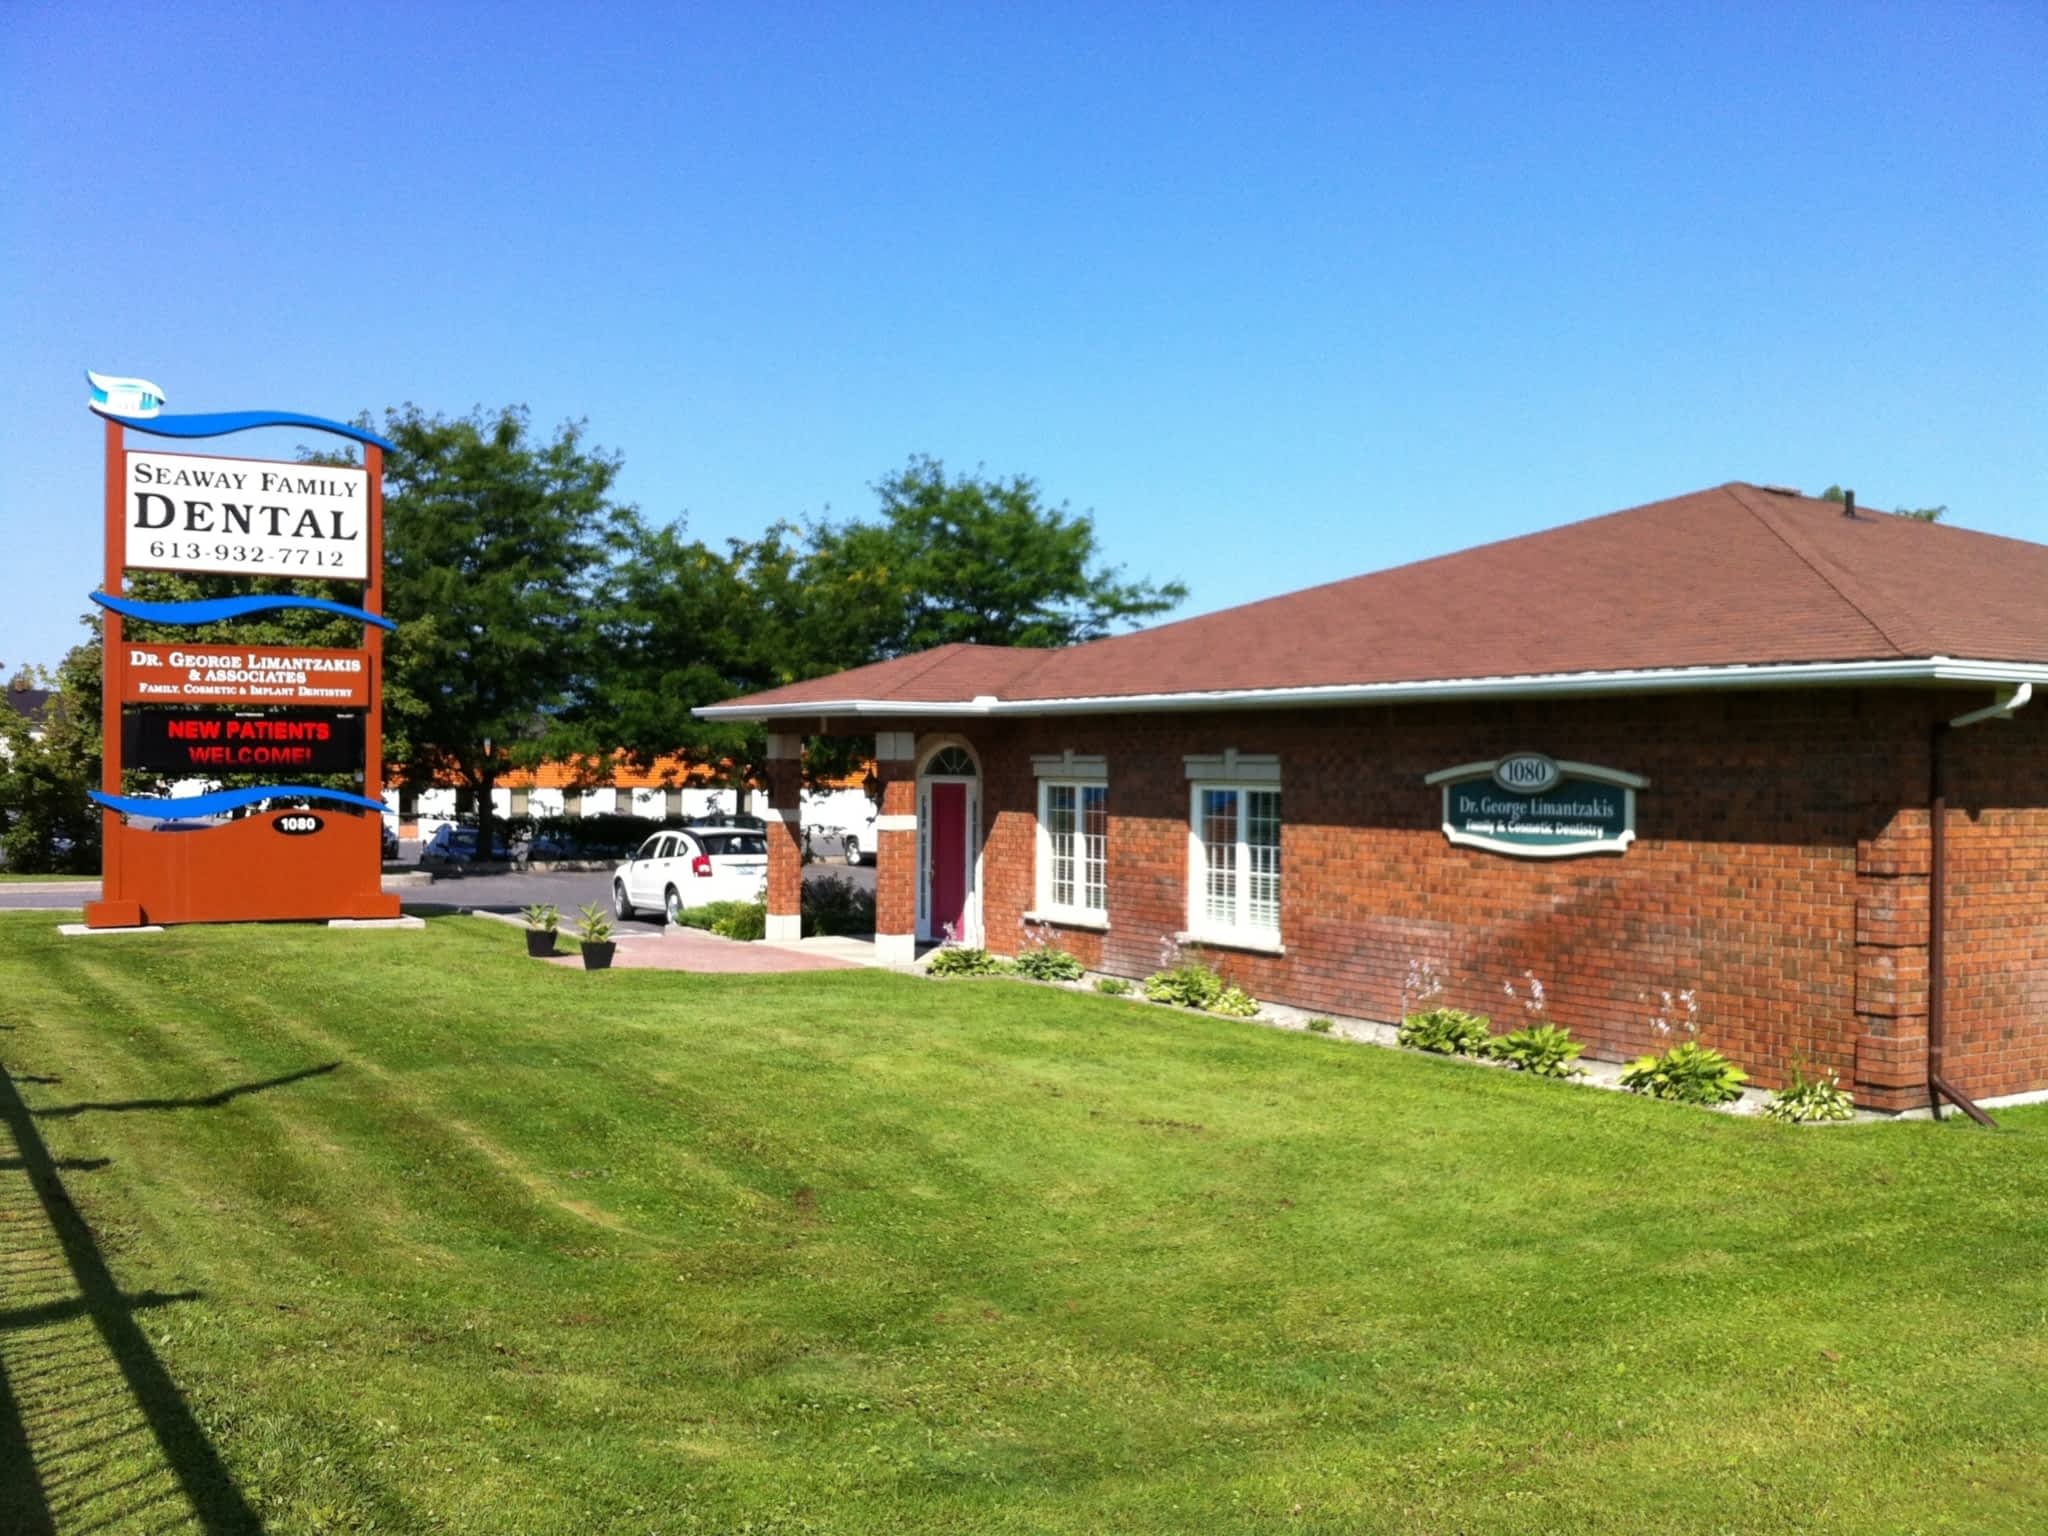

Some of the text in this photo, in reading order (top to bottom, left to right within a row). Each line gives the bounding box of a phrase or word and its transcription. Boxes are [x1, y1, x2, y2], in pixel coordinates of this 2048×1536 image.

[135, 463, 358, 498] SEAWAY FAMILY
[134, 492, 359, 541] DENTAL
[150, 541, 344, 567] 613-932-7712
[130, 650, 361, 672] DR. GEORGE LIMANTZAKIS
[188, 669, 307, 684] & ASSOCIATES
[184, 684, 237, 695] COSMETIC
[239, 686, 247, 695] &
[250, 685, 295, 697] IMPLANT
[298, 686, 353, 697] DENTISTRY
[168, 719, 331, 740] NEW PATIENTS
[188, 746, 312, 765] WELCOME!
[1508, 761, 1546, 782] 1080
[1460, 796, 1614, 820] Dr. George Limantzakis
[281, 818, 316, 831] 1080
[1555, 822, 1603, 840] Dentistry
